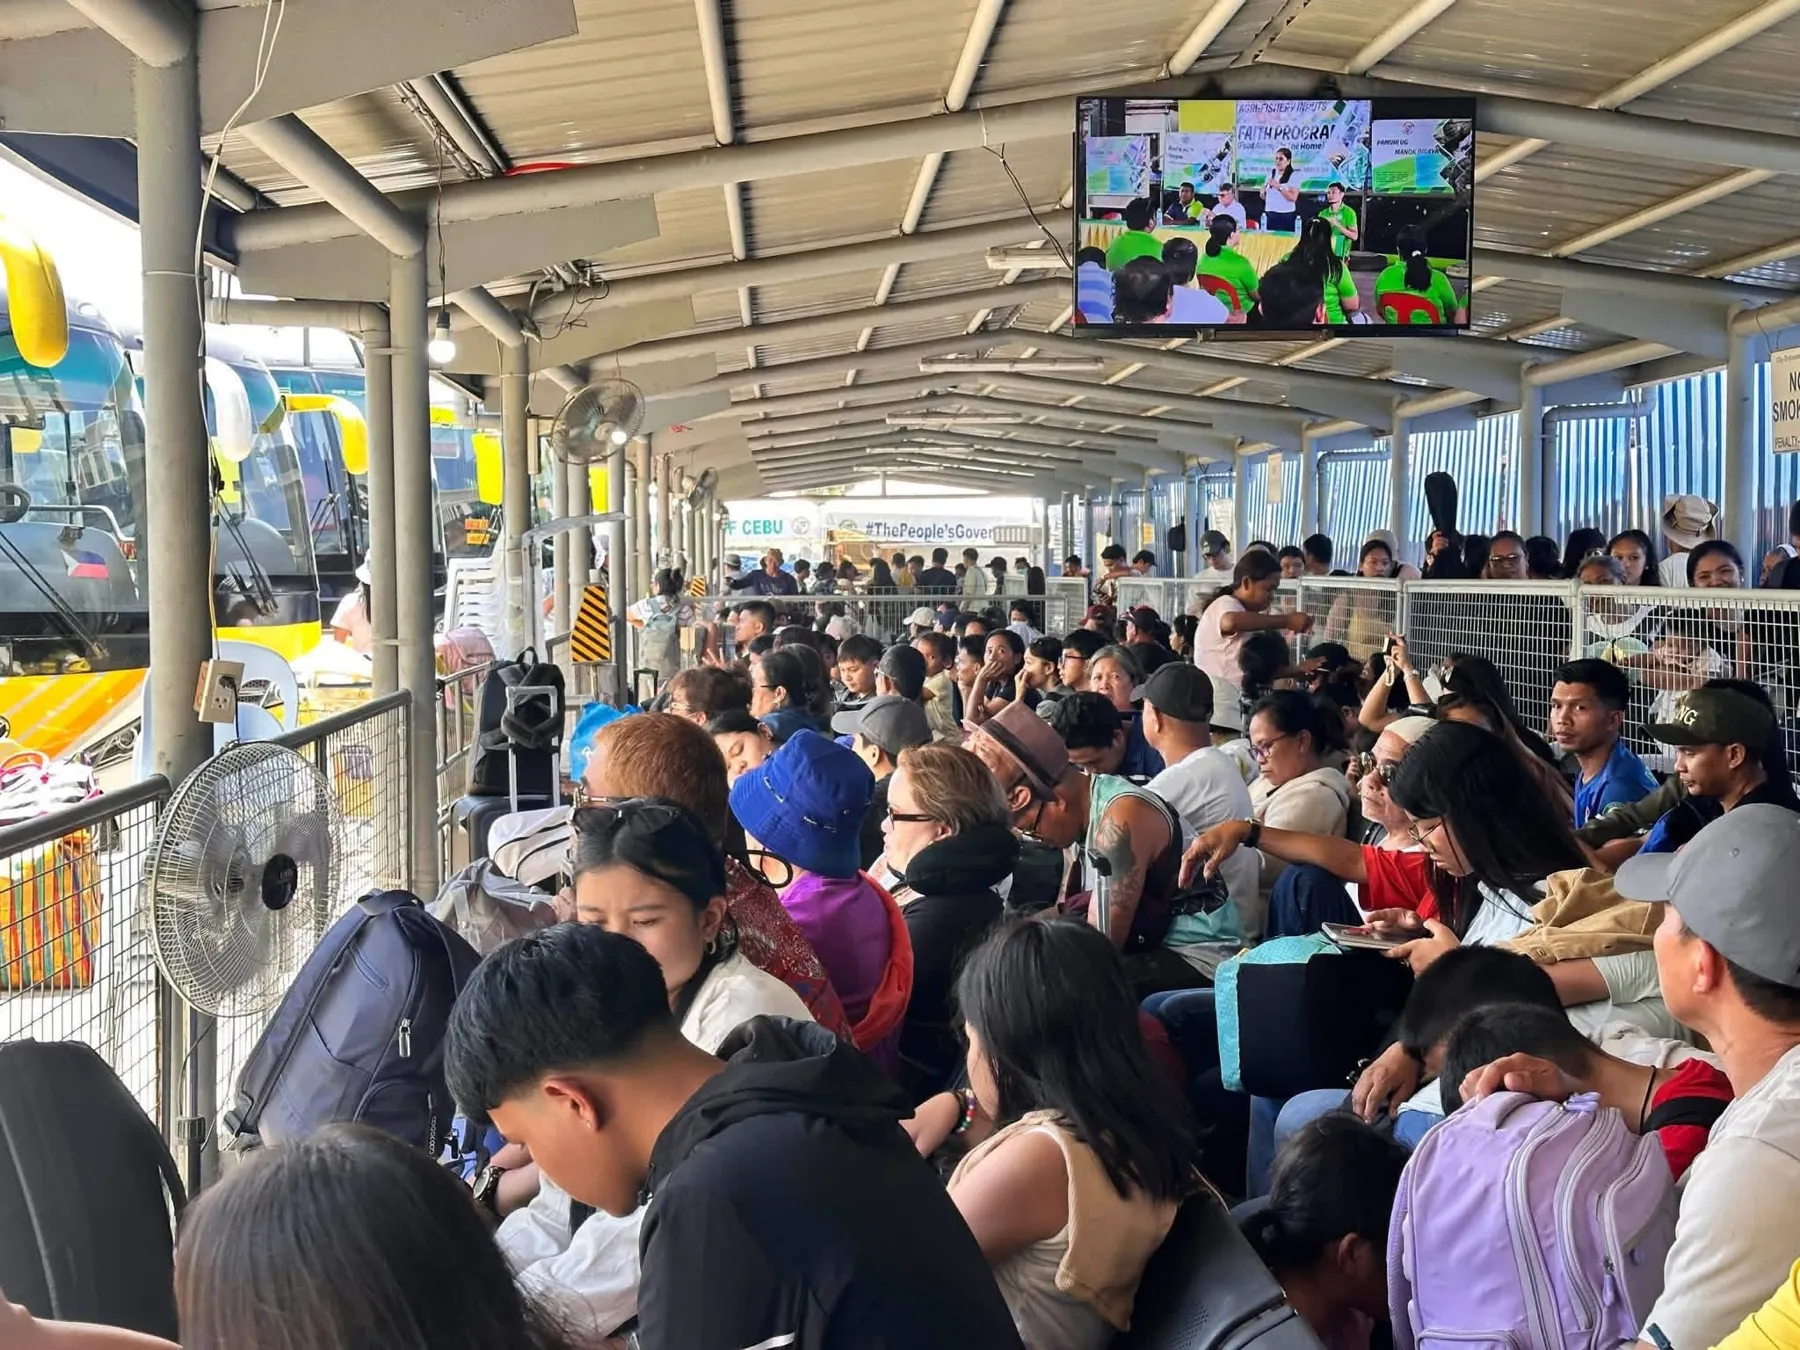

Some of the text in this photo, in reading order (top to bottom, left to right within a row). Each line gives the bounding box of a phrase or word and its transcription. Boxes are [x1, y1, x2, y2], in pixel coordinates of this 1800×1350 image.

[1238, 124, 1336, 140] FAITH PROGRA
[742, 519, 783, 535] CEBU
